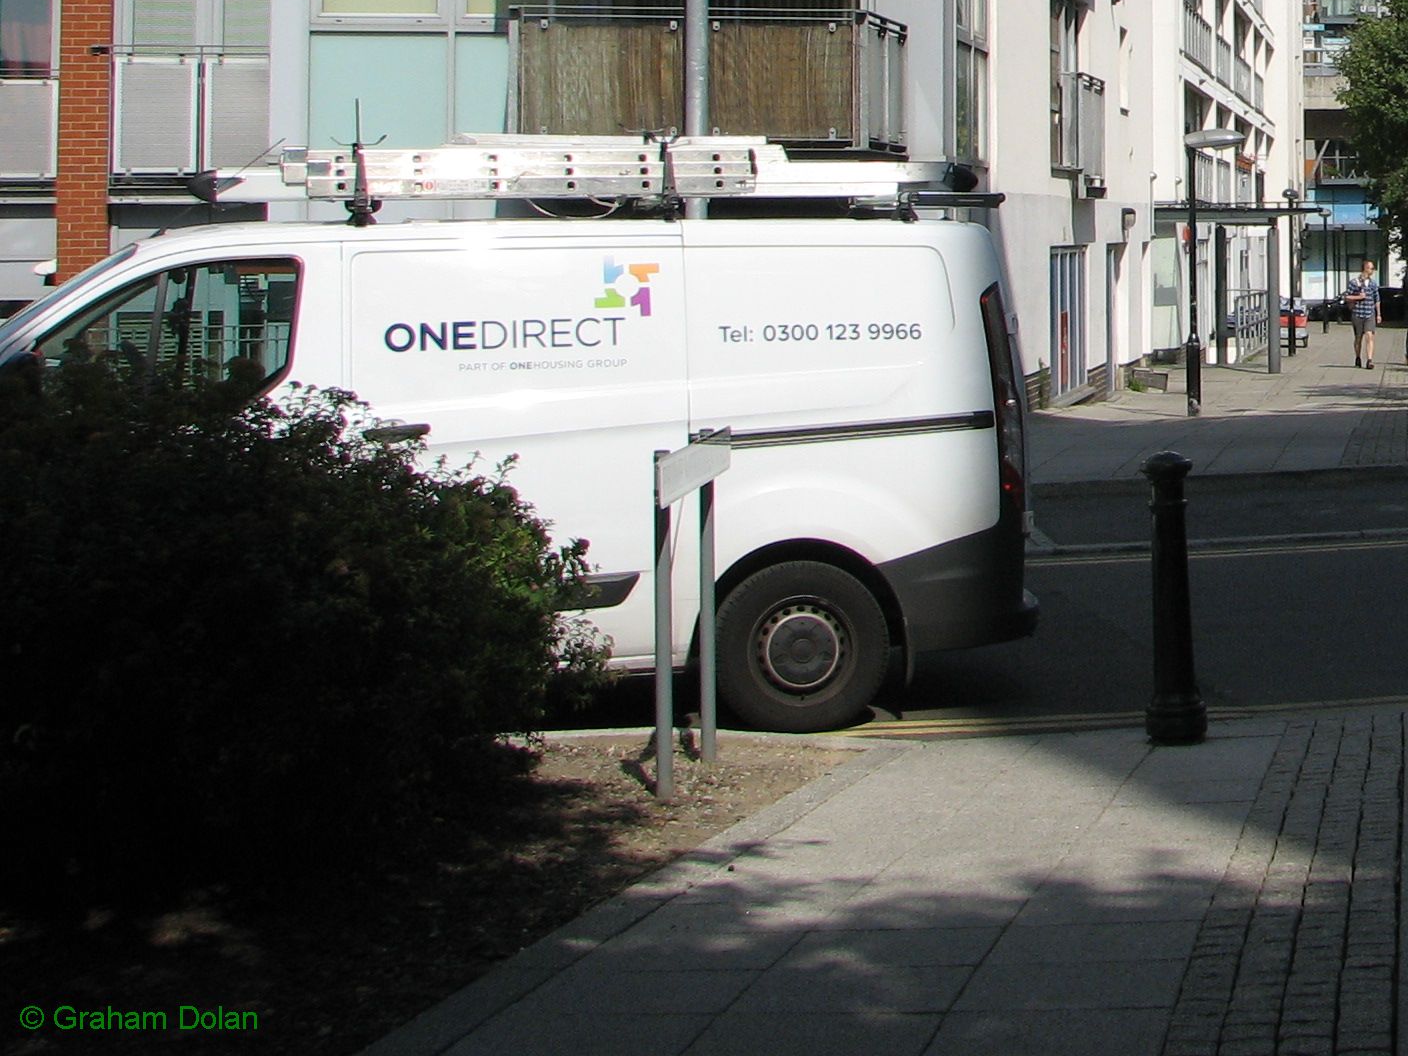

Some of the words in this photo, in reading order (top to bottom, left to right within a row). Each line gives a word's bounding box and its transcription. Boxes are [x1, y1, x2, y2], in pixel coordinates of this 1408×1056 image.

[384, 317, 626, 353] ONEDIRECT
[718, 325, 754, 343] Tel:
[762, 324, 819, 342] 0300
[826, 323, 861, 341] 123
[867, 323, 922, 340] 9966
[458, 361, 487, 372] PART
[491, 361, 507, 371] OF
[509, 360, 583, 371] ONEHOUSING
[587, 358, 628, 369] GROUP
